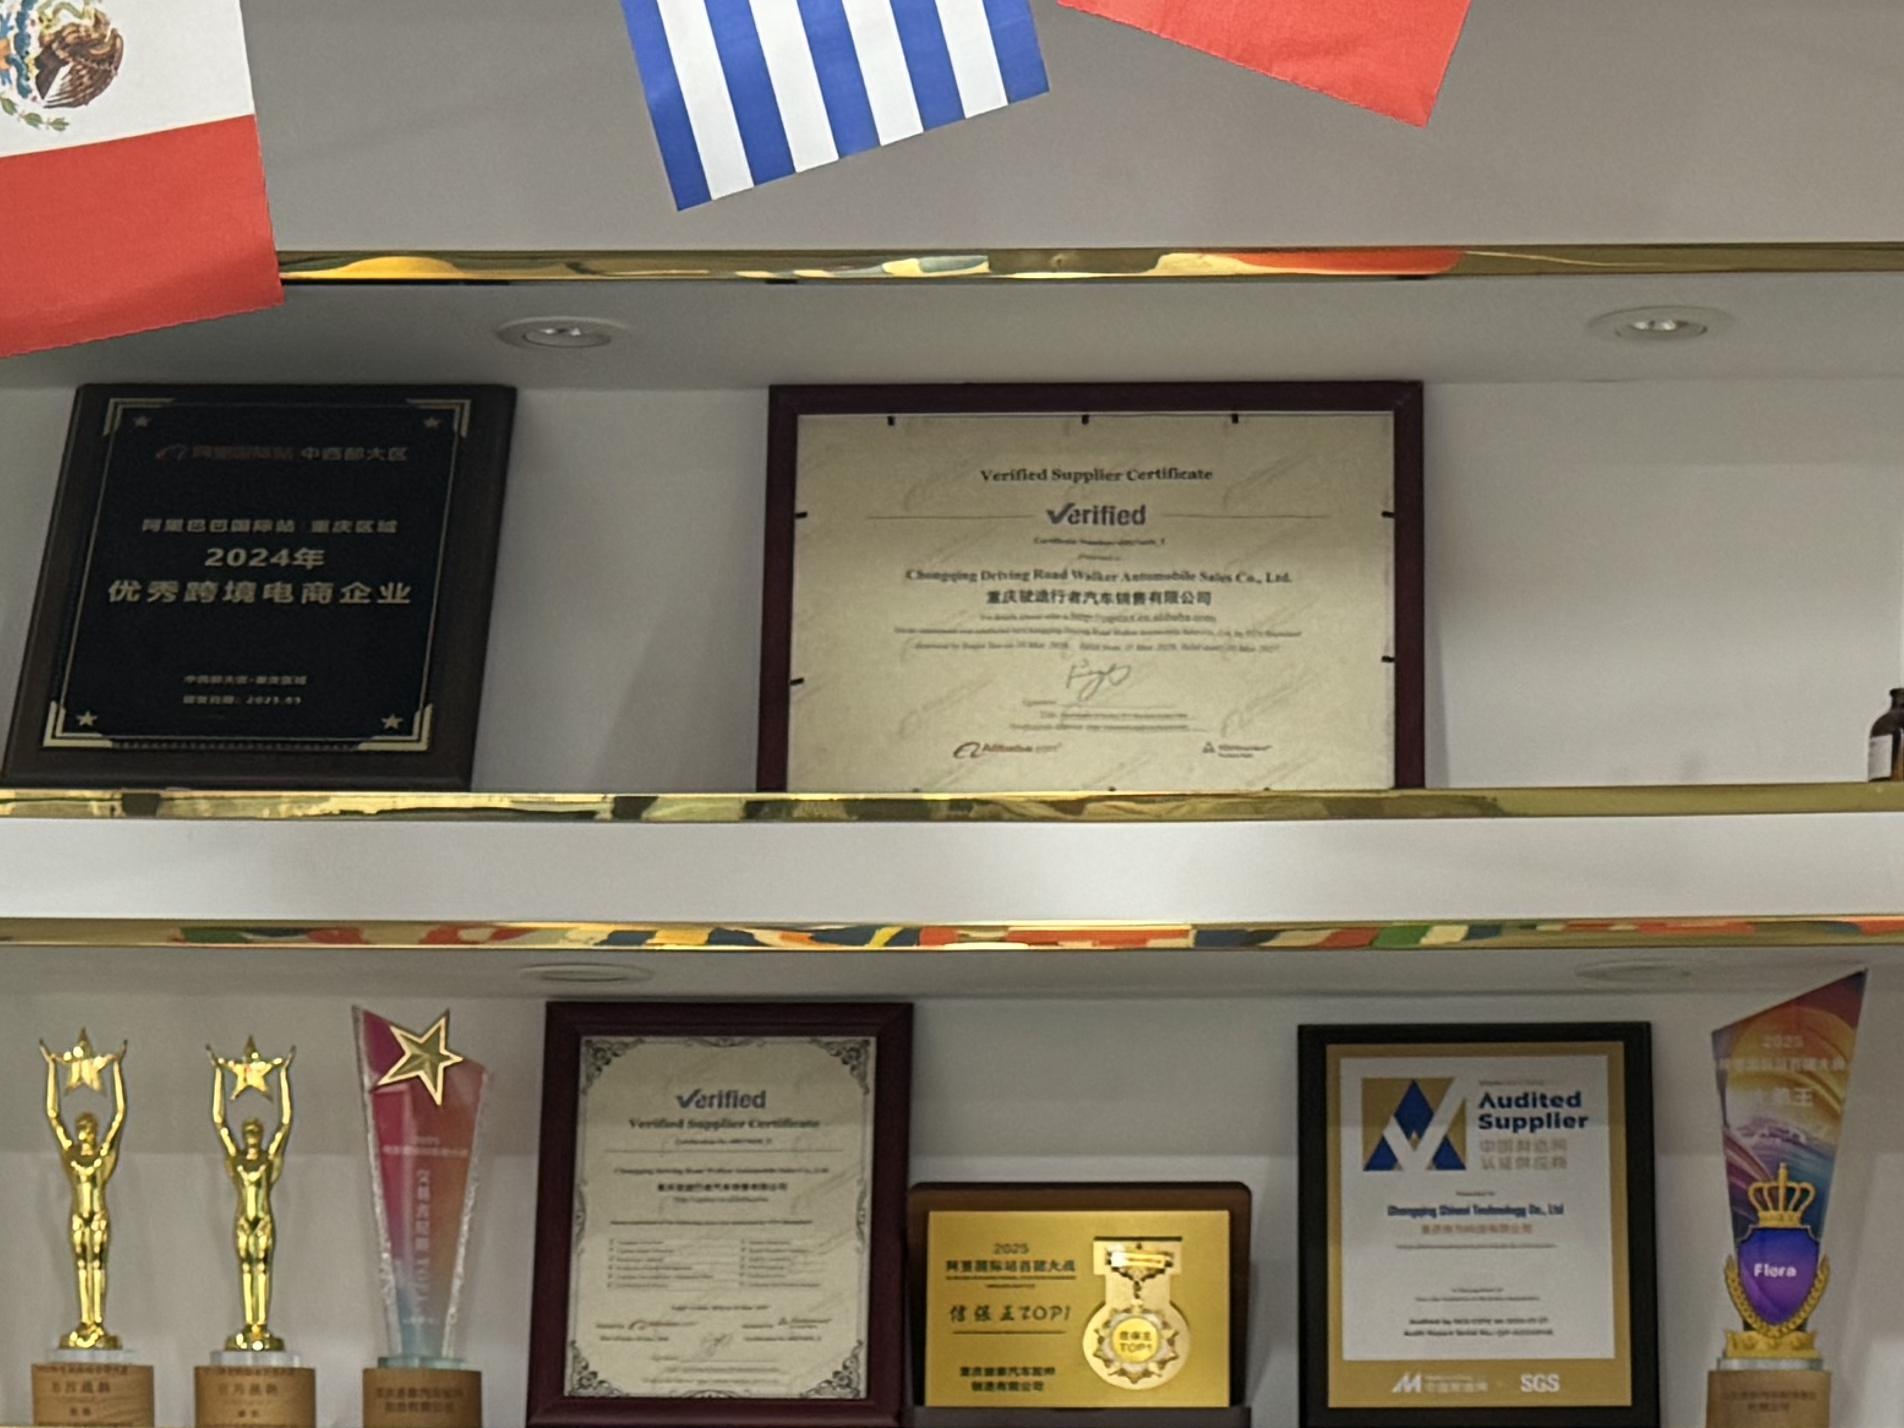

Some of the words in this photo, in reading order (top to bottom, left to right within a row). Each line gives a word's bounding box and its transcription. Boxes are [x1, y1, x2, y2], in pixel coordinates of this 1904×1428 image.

[980, 469, 1047, 482] Verified
[1051, 469, 1122, 483] Supplier
[1126, 468, 1213, 481] Certificate
[1047, 503, 1146, 526] Verified
[204, 548, 324, 569] 2024年
[108, 580, 411, 605] 优秀跨境电商企业
[676, 1089, 766, 1109] Verified
[1479, 1092, 1582, 1109] Audited
[1478, 1112, 1589, 1134] Supplier
[1520, 1373, 1560, 1393] SGS
